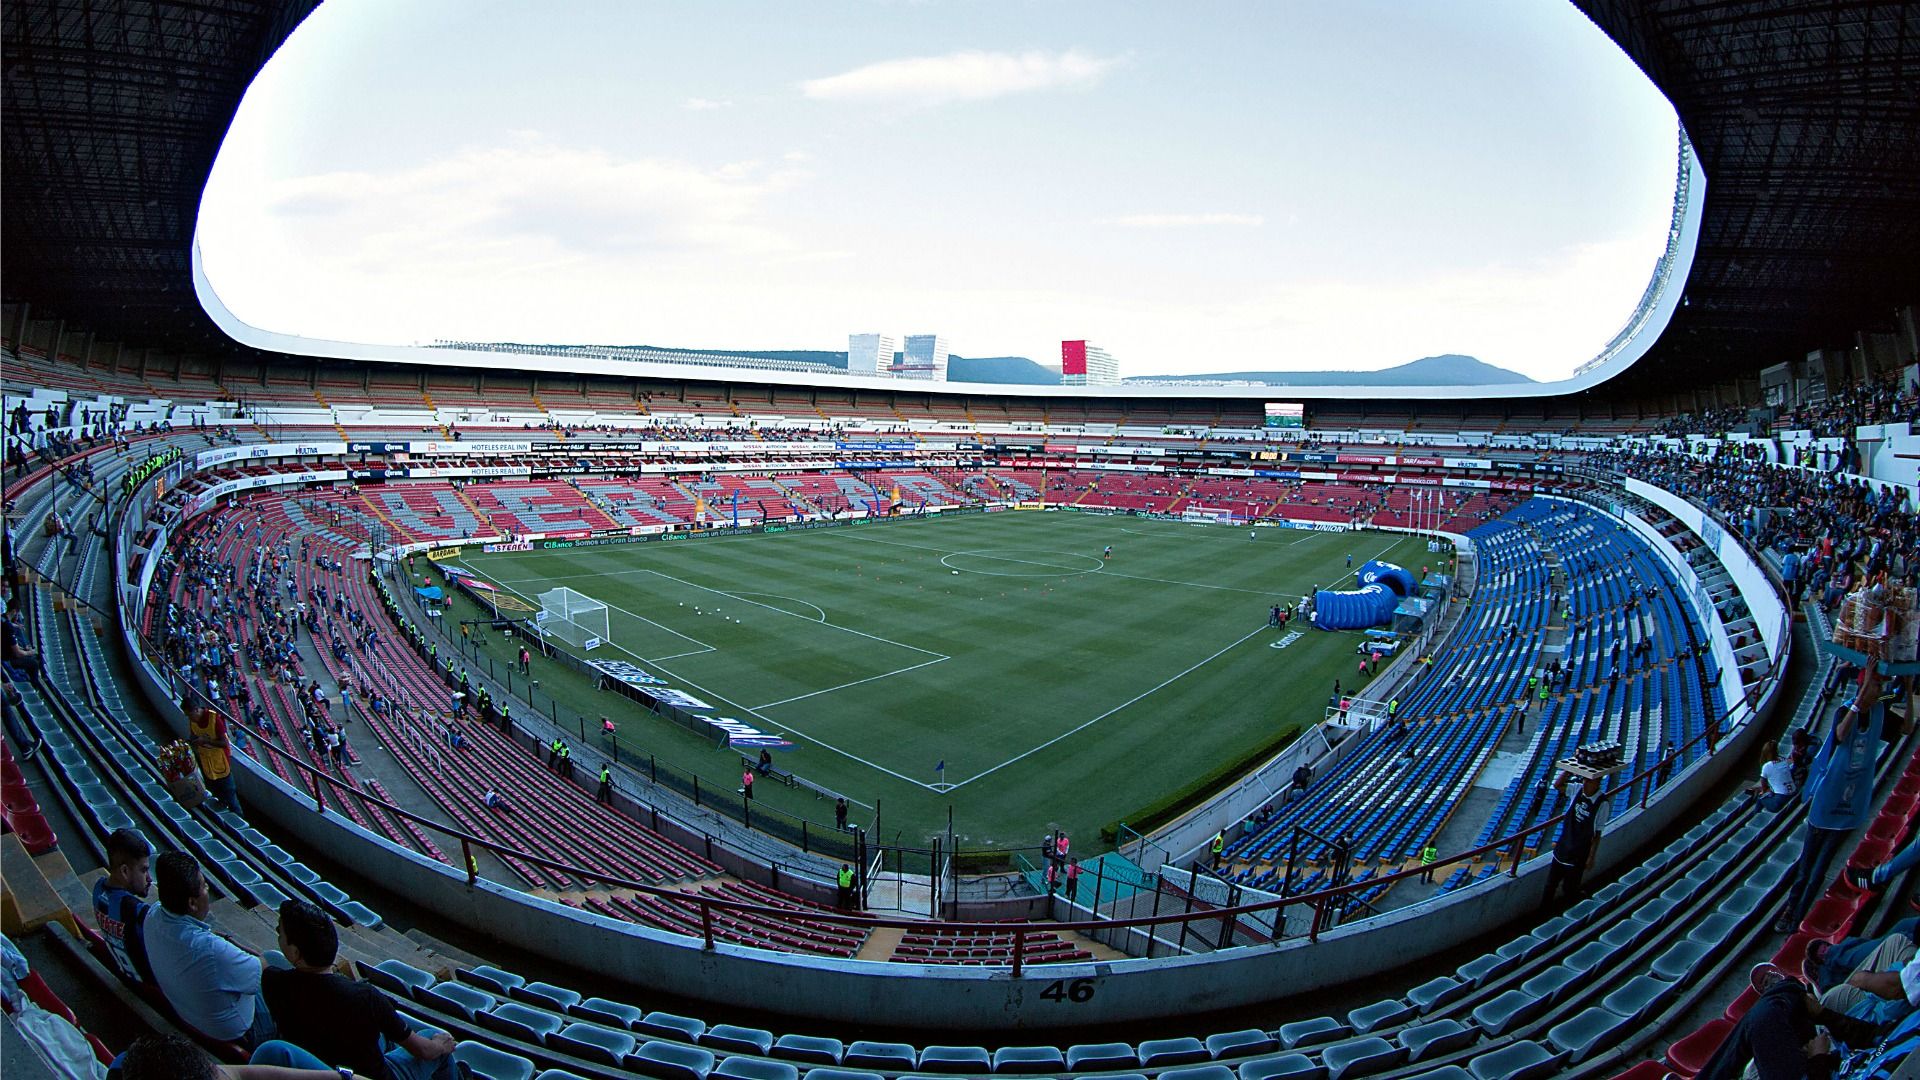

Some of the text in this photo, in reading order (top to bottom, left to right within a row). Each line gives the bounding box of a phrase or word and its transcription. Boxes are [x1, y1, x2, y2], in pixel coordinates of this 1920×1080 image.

[1314, 524, 1344, 532] UNION
[496, 543, 528, 552] STEREN
[543, 541, 572, 549] CIBanco
[575, 539, 598, 547] Somos
[432, 547, 456, 558] BARDAHL
[1040, 978, 1095, 1003] 46
